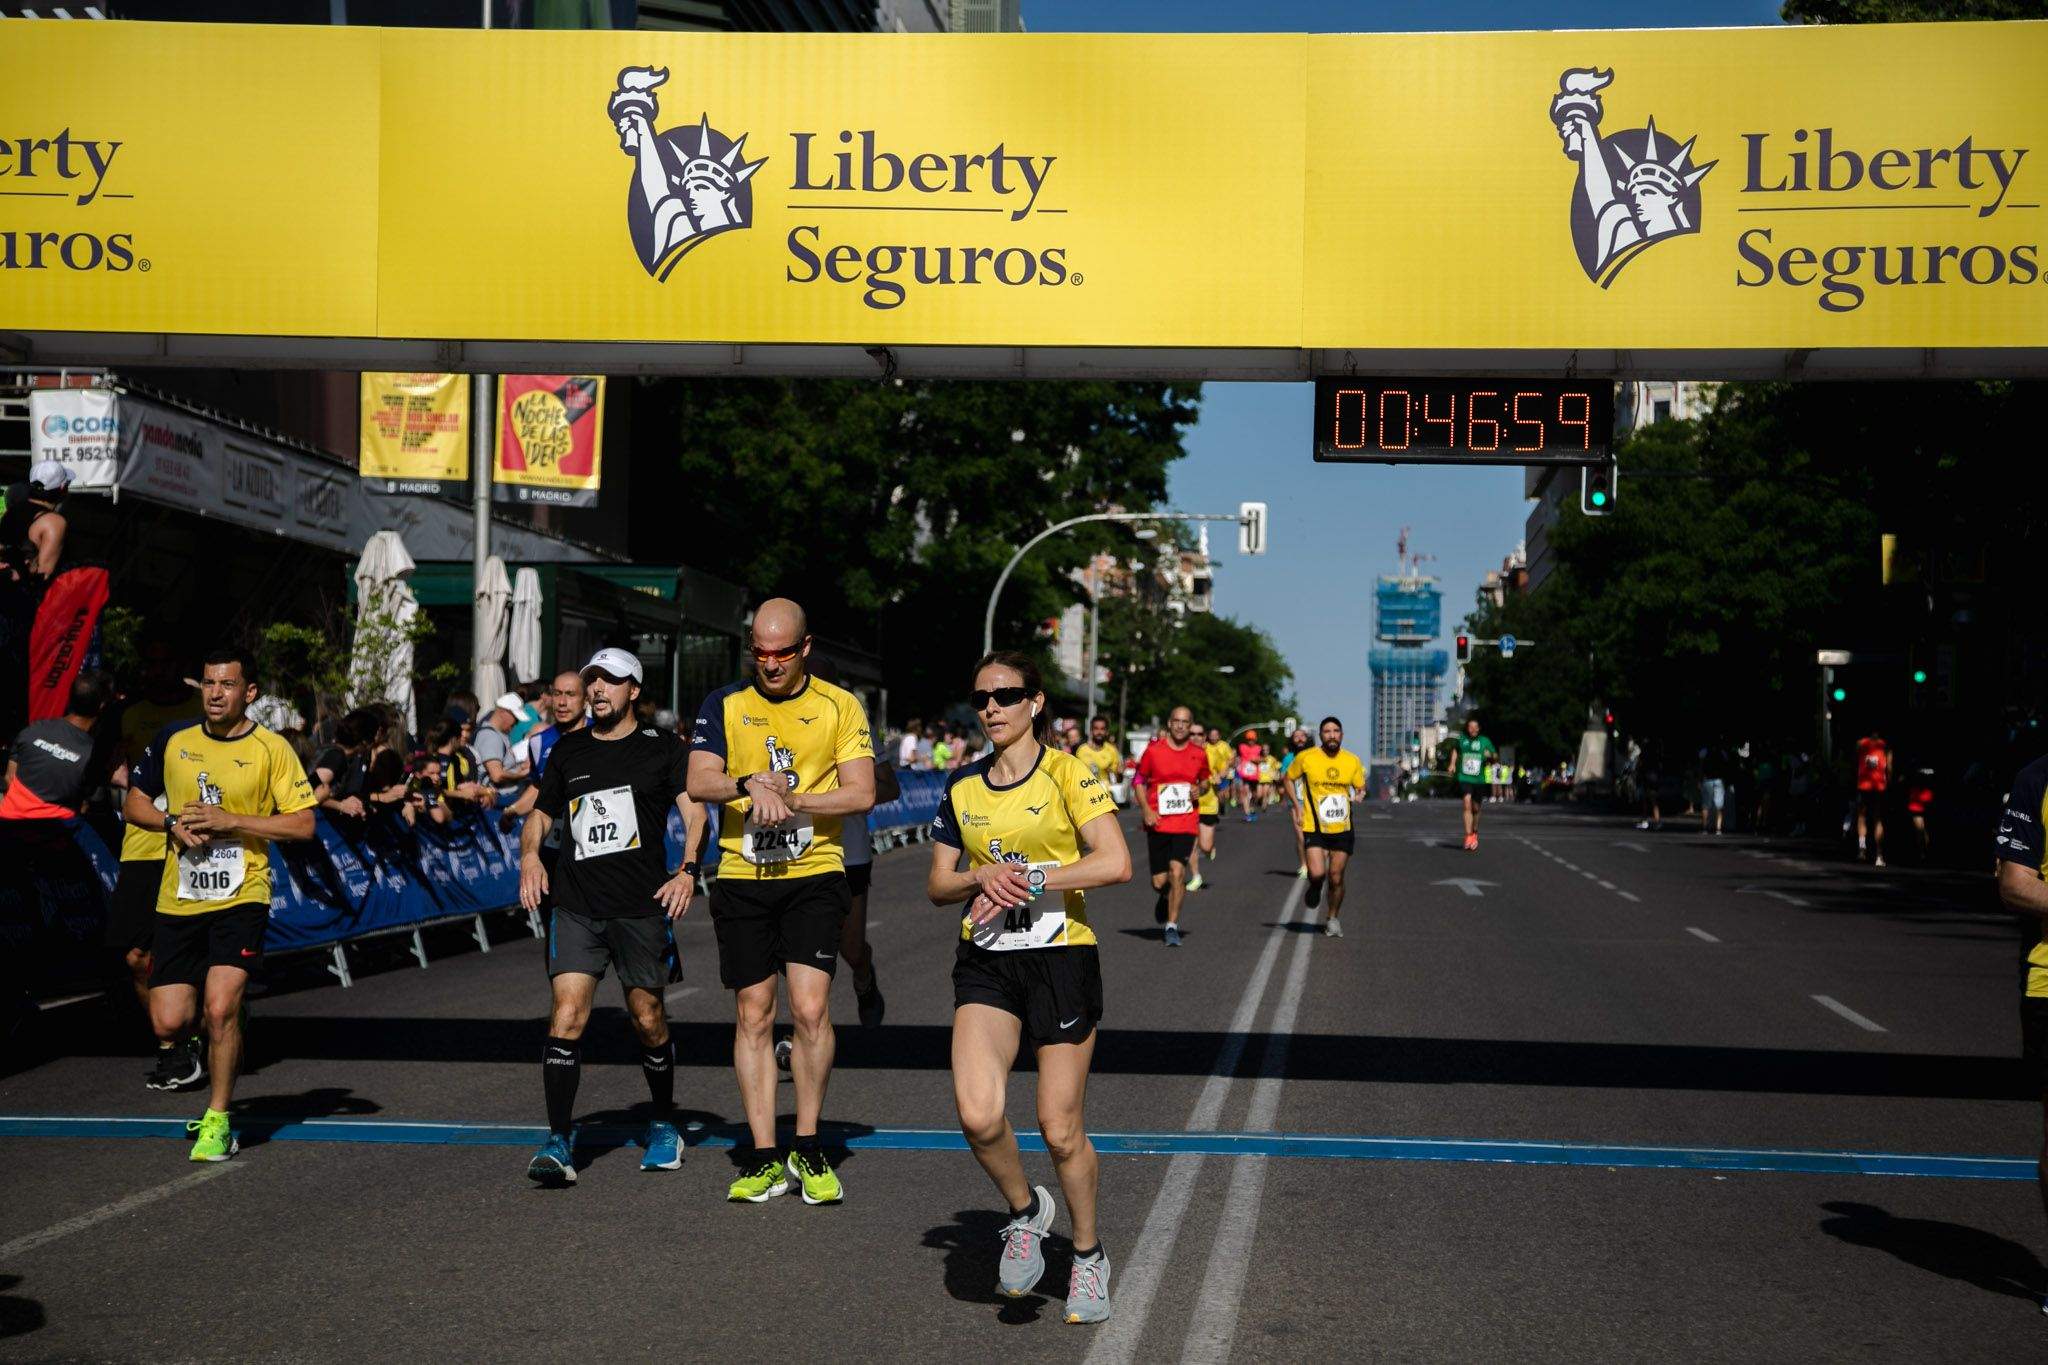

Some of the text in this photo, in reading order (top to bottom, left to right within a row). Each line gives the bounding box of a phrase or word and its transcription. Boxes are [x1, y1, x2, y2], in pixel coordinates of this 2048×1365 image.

[789, 130, 1057, 221] Liberty
[1739, 127, 2030, 218] Liberty
[529, 393, 547, 406] LA
[514, 399, 563, 426] NOCHE
[1334, 389, 1590, 451] 00:46:59
[521, 424, 537, 439] DE
[76, 446, 102, 462] 952
[399, 482, 441, 494] MADRID
[531, 490, 573, 502] MADRID
[787, 774, 796, 787] 3
[588, 822, 619, 845] 472
[214, 849, 237, 859] 2604
[189, 871, 230, 889] 2016
[1003, 907, 1034, 933] 44
